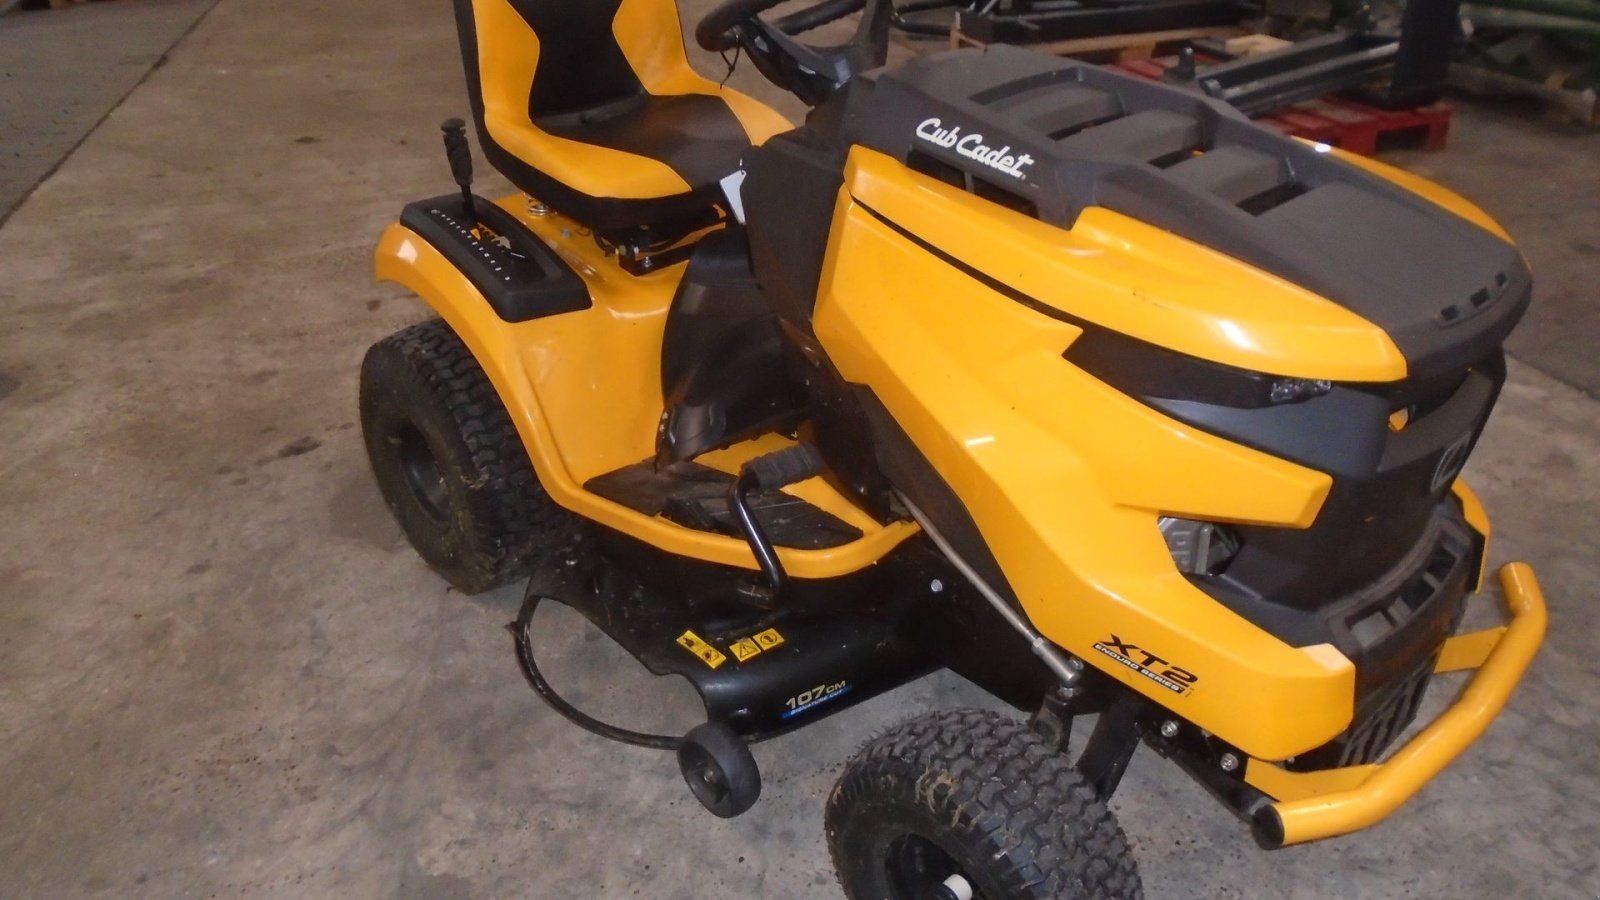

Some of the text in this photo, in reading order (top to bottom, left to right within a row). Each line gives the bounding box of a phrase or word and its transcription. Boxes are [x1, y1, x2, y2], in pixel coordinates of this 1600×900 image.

[916, 118, 1034, 178] Cub Cadet
[1094, 644, 1180, 691] ENDURO SERIES
[1098, 633, 1198, 687] XT2
